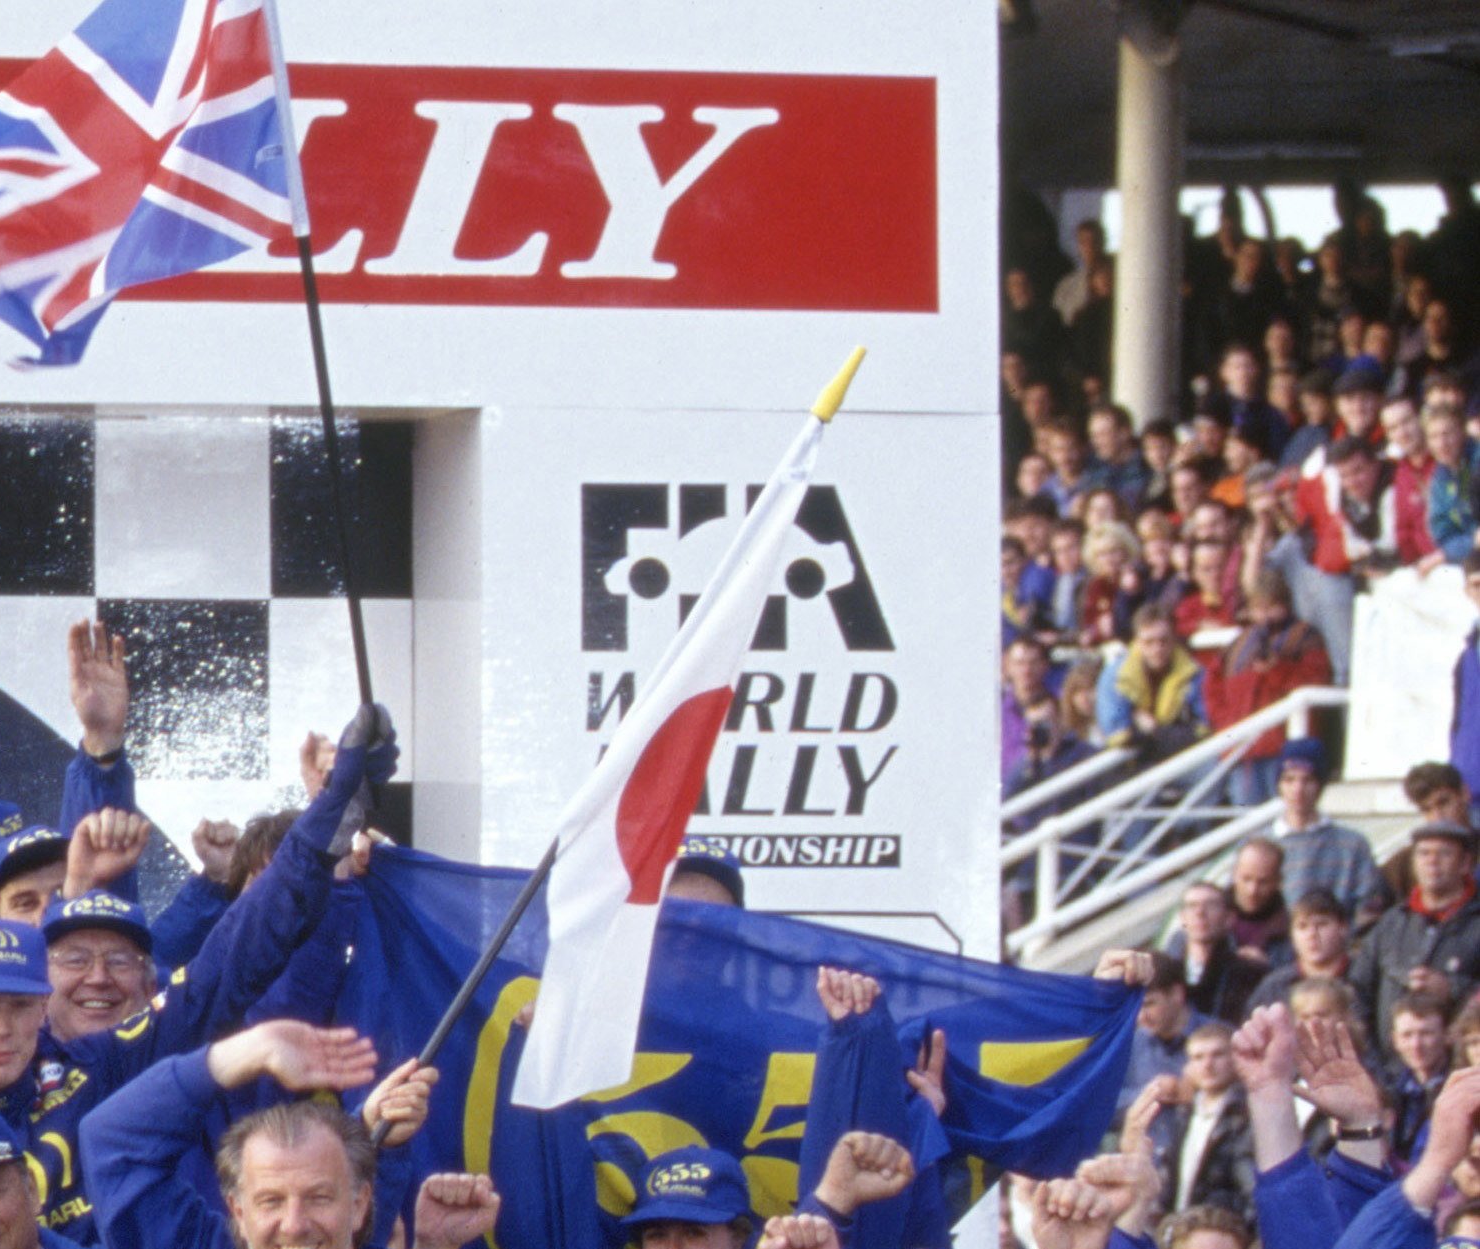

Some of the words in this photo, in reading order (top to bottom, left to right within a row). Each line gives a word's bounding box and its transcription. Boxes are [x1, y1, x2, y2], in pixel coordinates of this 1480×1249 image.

[586, 671, 899, 732] WRLD
[596, 745, 899, 816] LLY
[656, 1163, 711, 1187] 555
